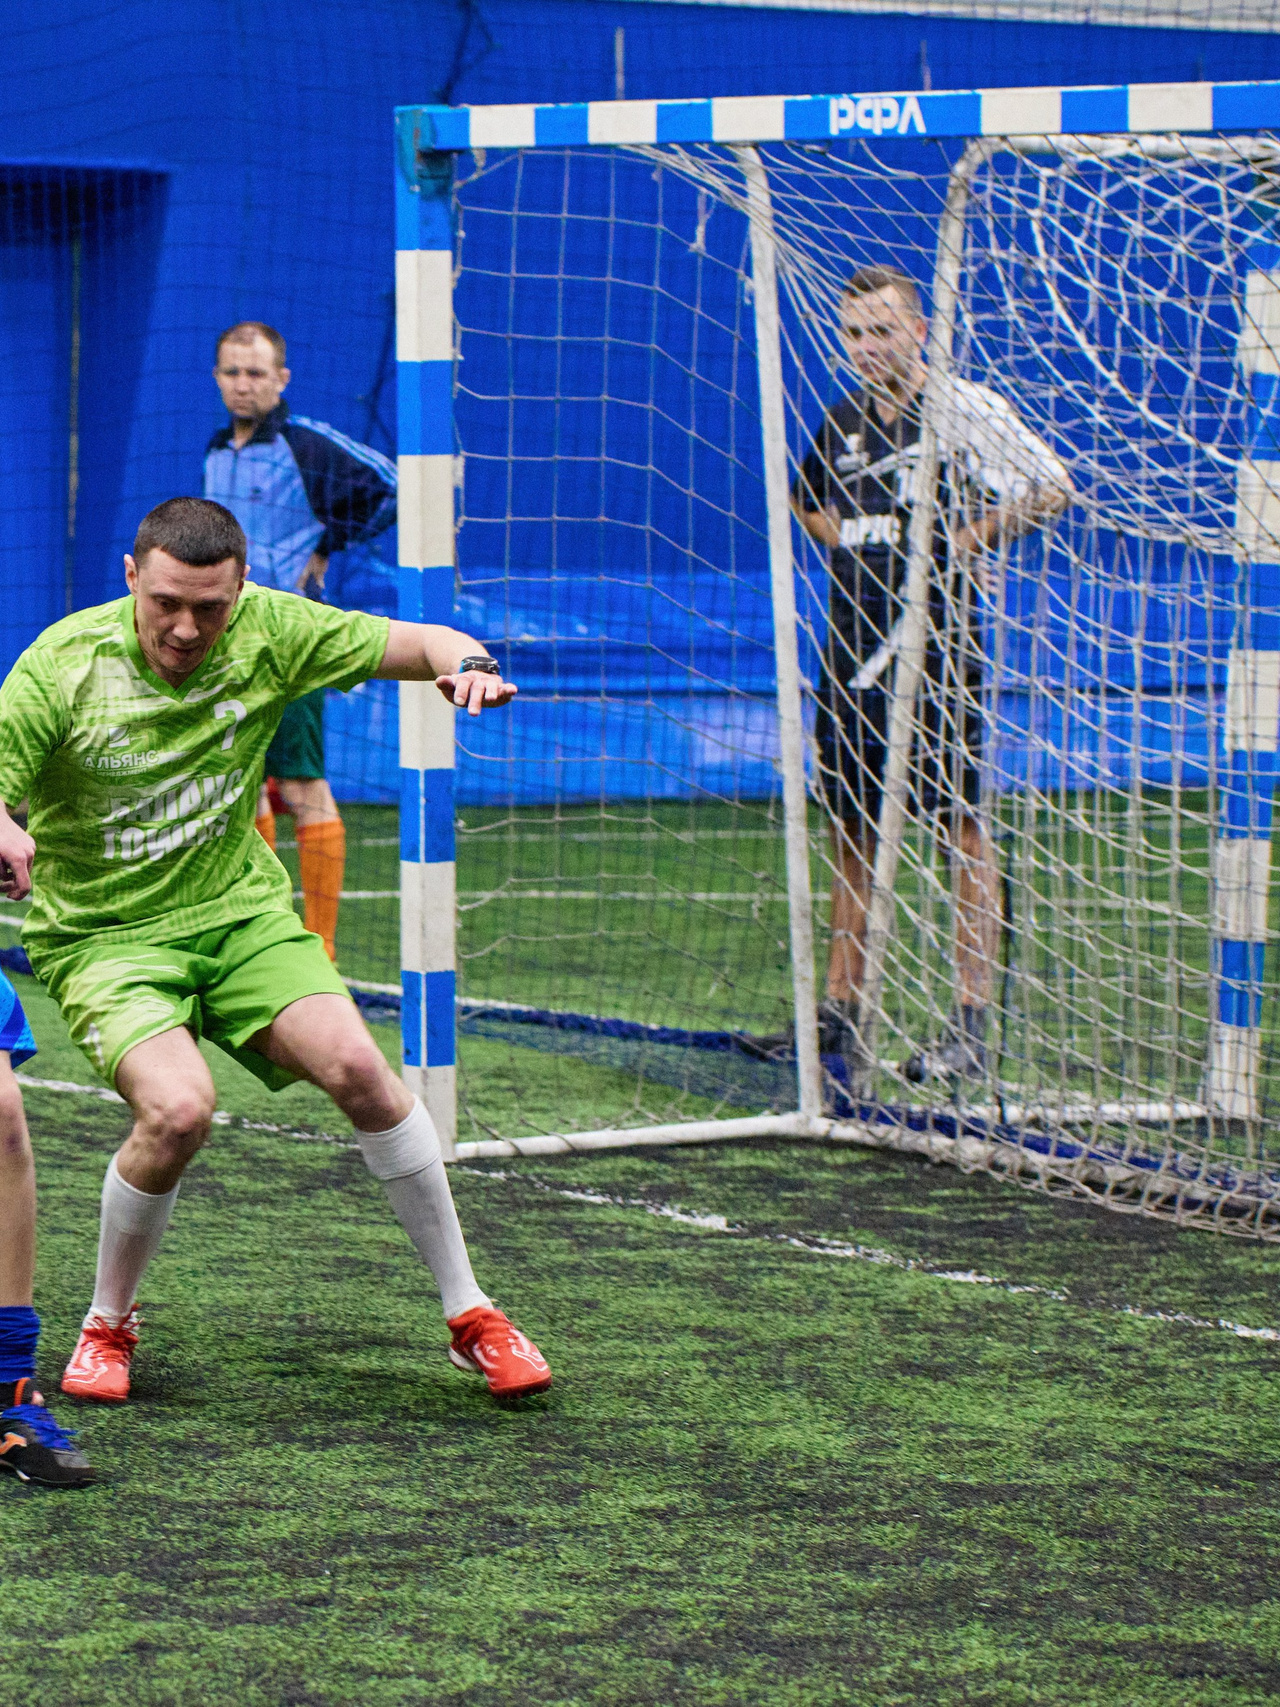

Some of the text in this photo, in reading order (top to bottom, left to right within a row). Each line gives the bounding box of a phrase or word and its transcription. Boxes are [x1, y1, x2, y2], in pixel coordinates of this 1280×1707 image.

[829, 96, 927, 135] РФЛ
[213, 699, 248, 750] 7
[84, 749, 159, 769] АЛЬЯНС
